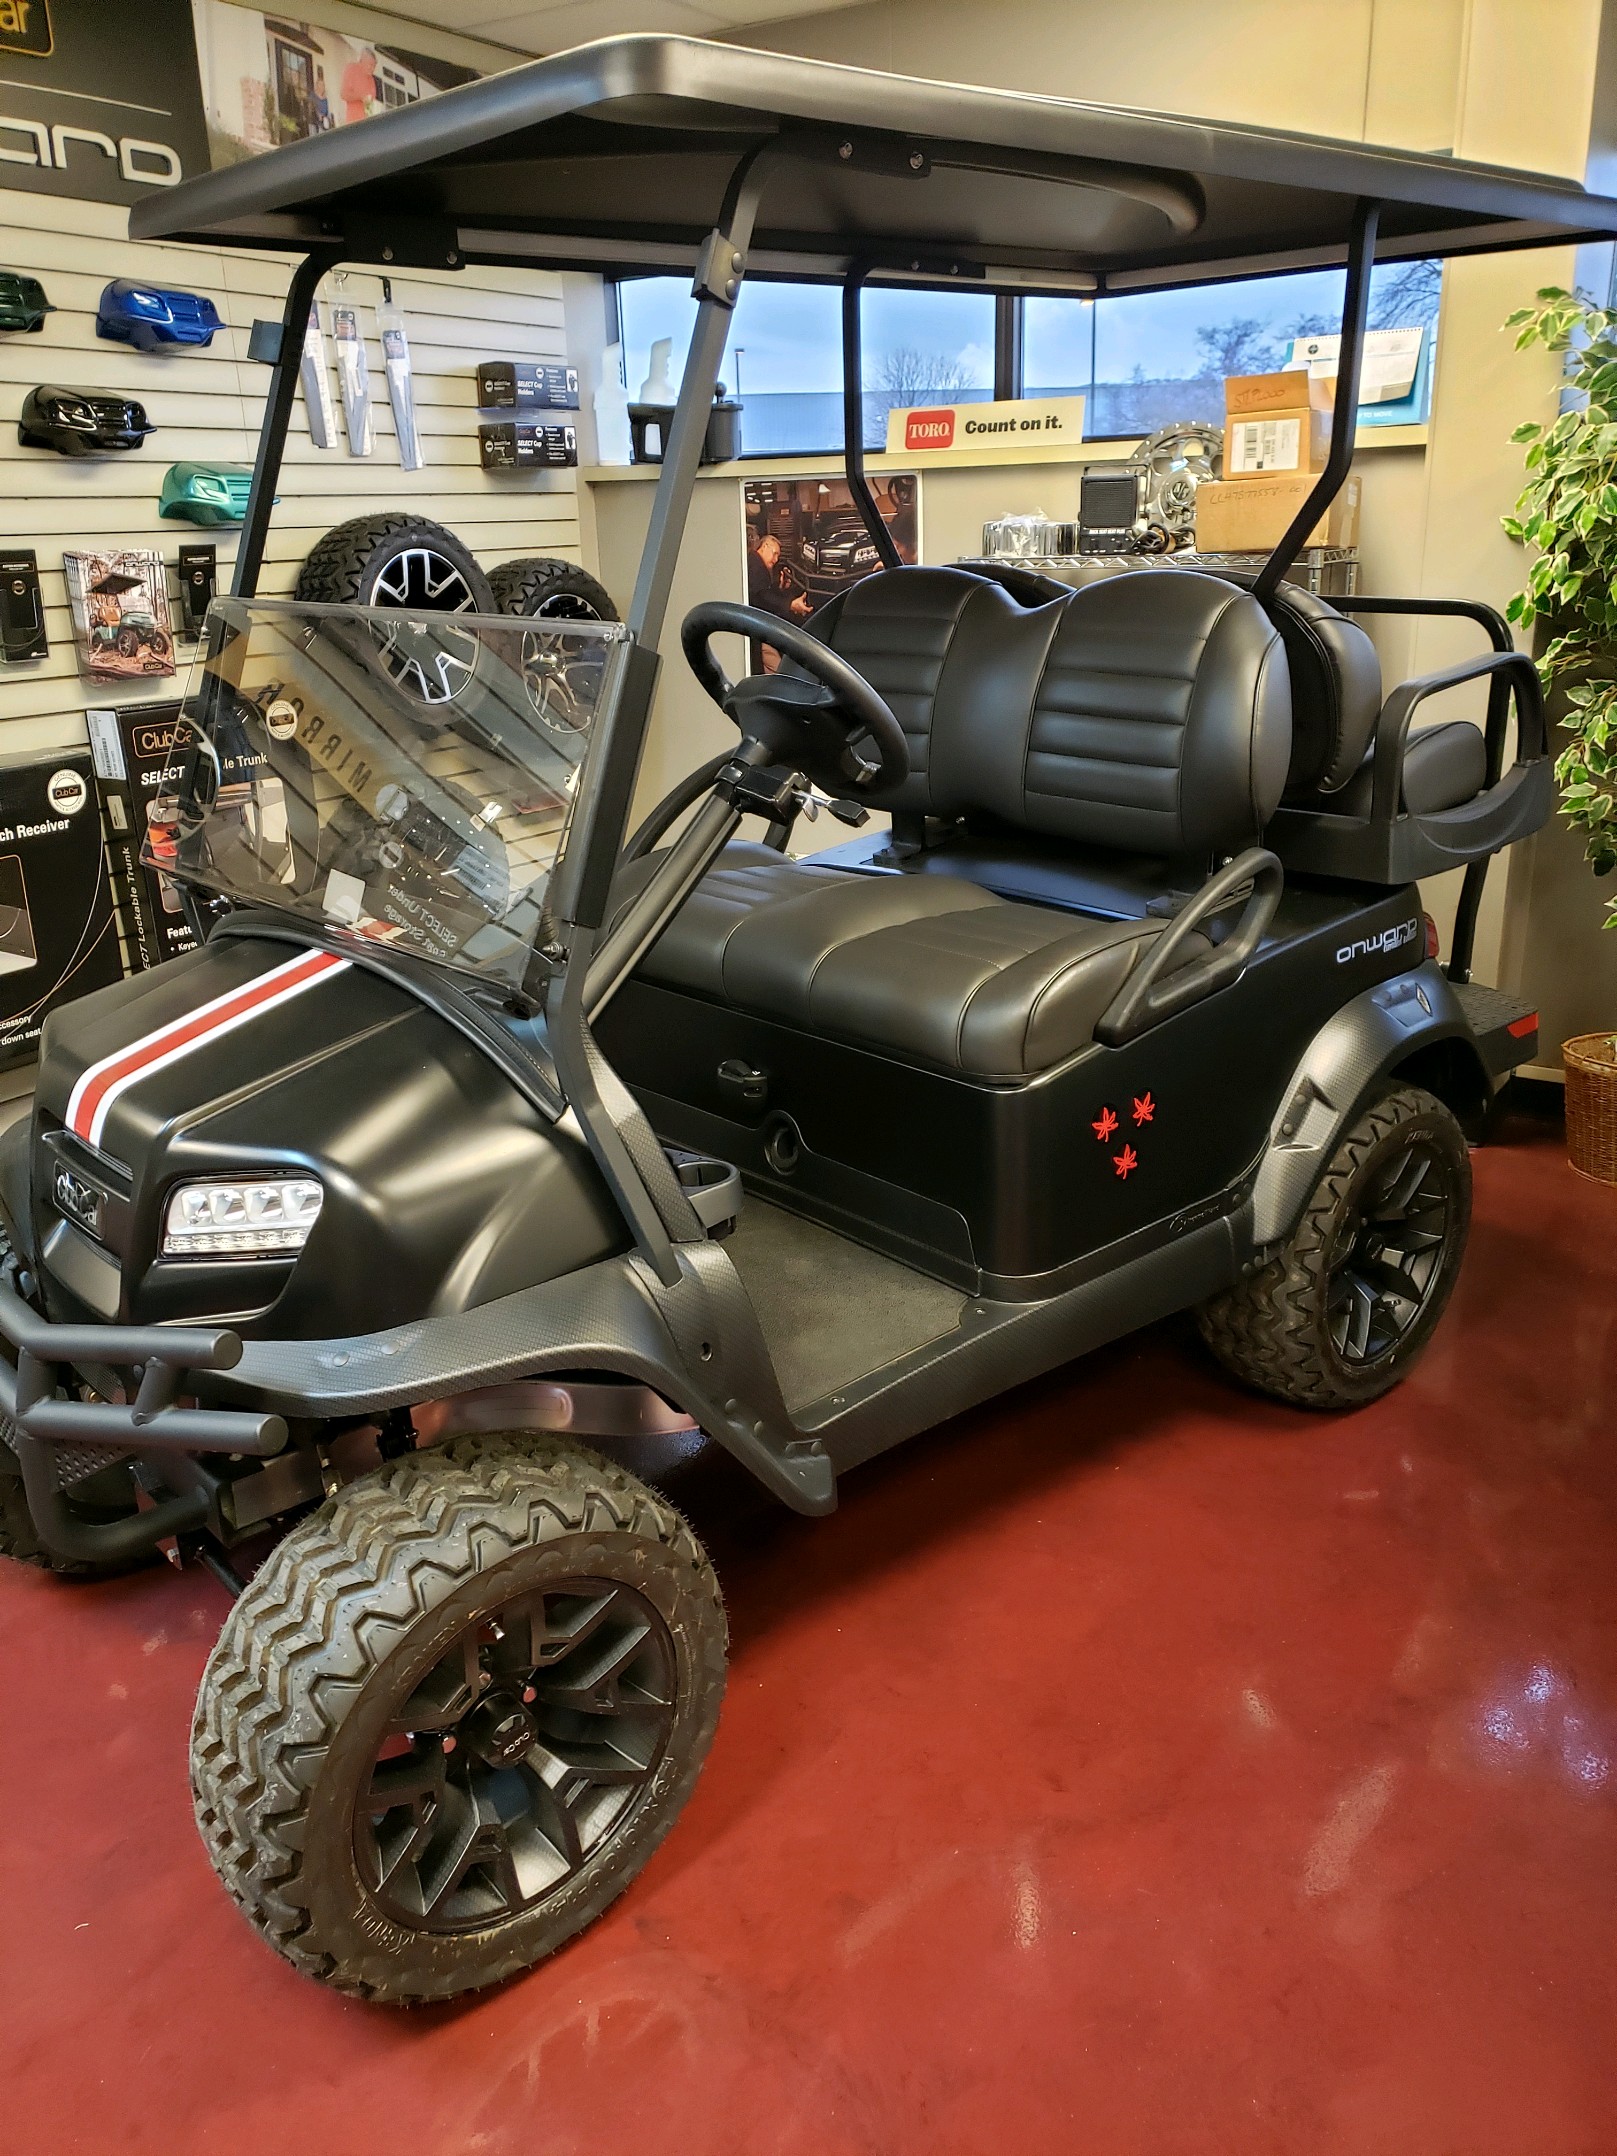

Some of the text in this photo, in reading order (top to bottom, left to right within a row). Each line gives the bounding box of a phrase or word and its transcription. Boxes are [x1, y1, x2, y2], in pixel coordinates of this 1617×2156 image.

[909, 422, 950, 439] TORO
[965, 415, 1063, 434] Count on it.
[236, 752, 268, 767] Trunk
[141, 765, 186, 786] SELECT
[16, 819, 70, 838] Receiver
[122, 846, 135, 883] Trunk
[131, 886, 146, 942] Lockable
[178, 941, 198, 952] Keye
[25, 1027, 42, 1039] seat
